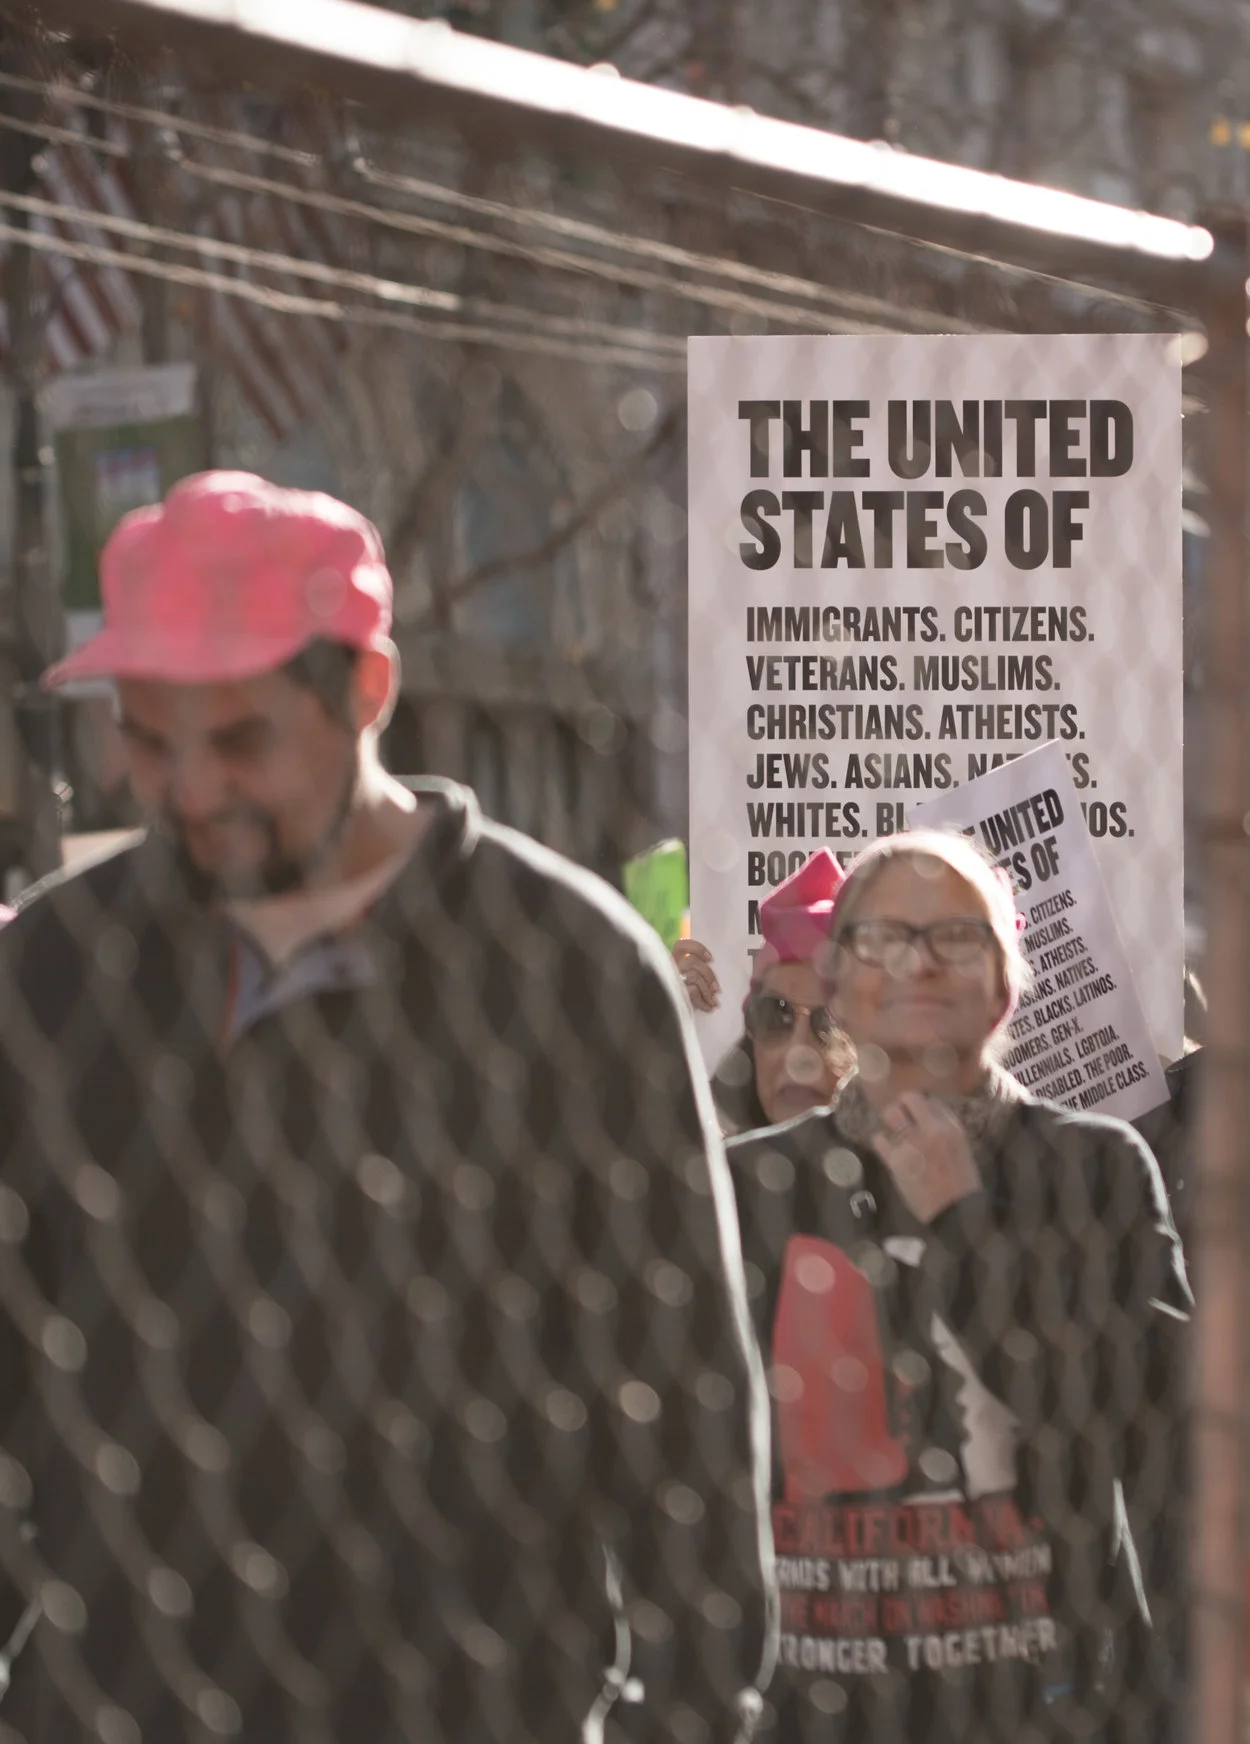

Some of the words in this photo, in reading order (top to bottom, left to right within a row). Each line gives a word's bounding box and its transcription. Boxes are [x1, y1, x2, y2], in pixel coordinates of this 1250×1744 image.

[739, 400, 870, 478] THE
[888, 400, 1134, 480] UNITED
[739, 489, 988, 571] STATES
[1004, 489, 1090, 571] OF
[746, 606, 946, 643] IMMIGRANTS.
[954, 606, 1095, 643] CITIZENS.
[746, 655, 905, 692] VETERANS.
[914, 655, 1060, 692] MUSLIMS.
[746, 704, 931, 740] CHRISTIANS.
[938, 704, 1086, 740] ATHEISTS.
[747, 753, 837, 789] JEWS.
[845, 752, 959, 789] ASIANS.
[747, 802, 868, 838] WHITES.
[979, 788, 1065, 857] UNITED
[1030, 835, 1059, 882] OF
[1030, 889, 1077, 924] CITIZENS.
[1024, 917, 1074, 954] MUSLIMS.
[1039, 936, 1088, 973] ATHEISTS.
[1054, 957, 1099, 992] NATIVES.
[1033, 995, 1075, 1028] BLACKS.
[1073, 974, 1117, 1007] LATINOS.
[1050, 1016, 1084, 1046] GEN-X.
[1014, 1047, 1075, 1087] ILLENNIALS.
[1074, 1024, 1120, 1059] LGBTQIA.
[1036, 1069, 1086, 1099] DISABLED.
[1083, 1057, 1105, 1081] THE
[1102, 1043, 1134, 1071] POOR.
[1078, 1075, 1117, 1110] MIDDLE
[1116, 1061, 1150, 1090] CLASS.
